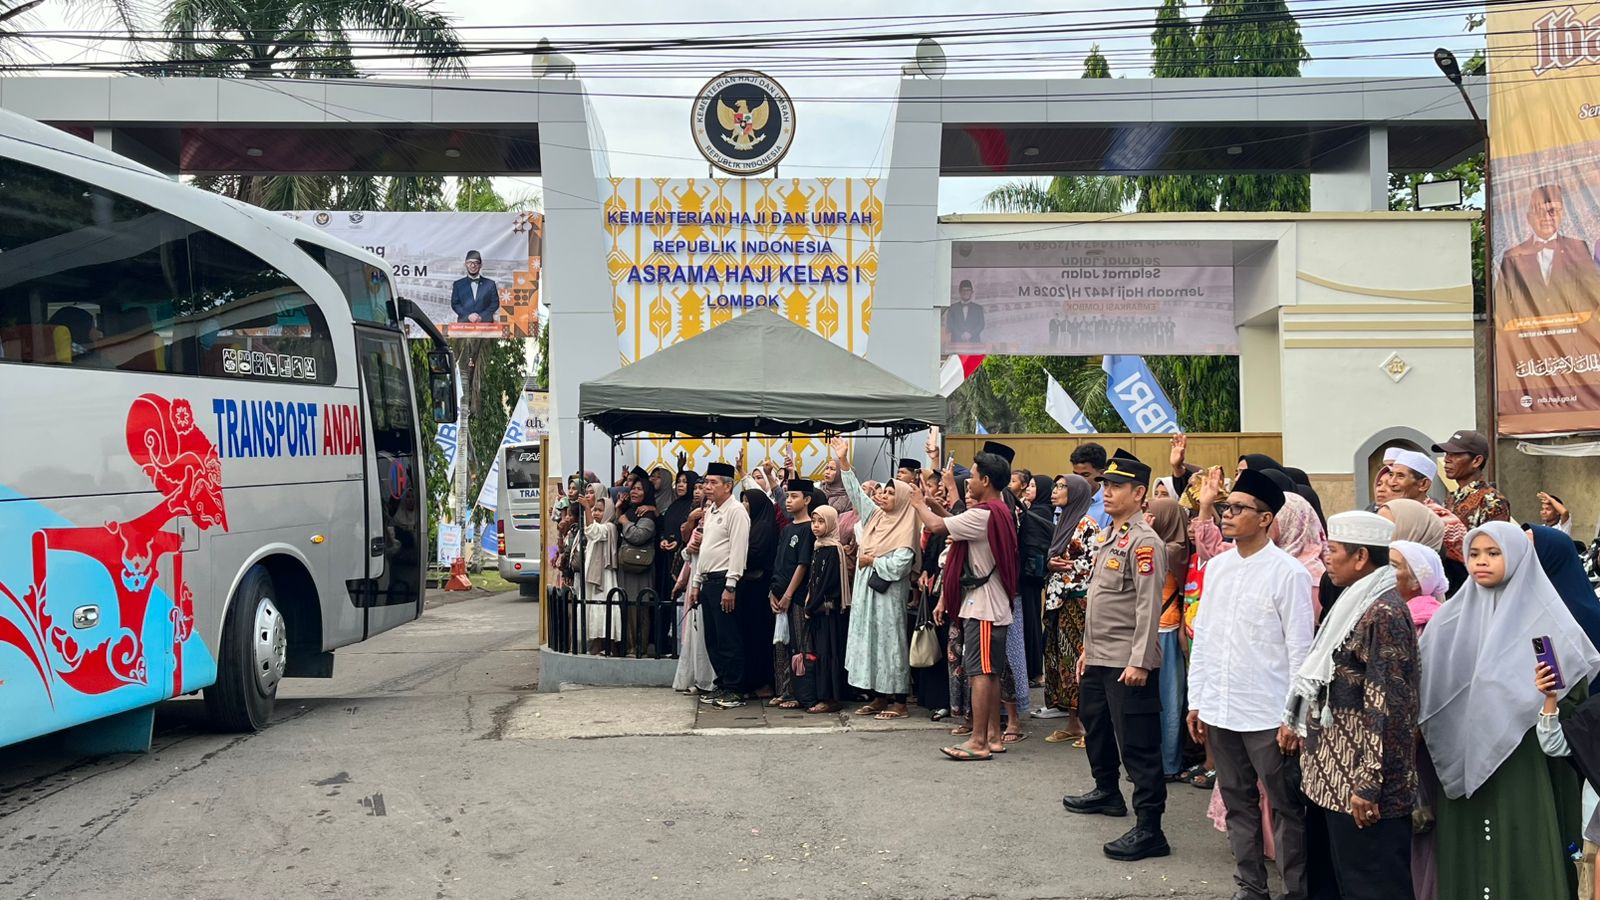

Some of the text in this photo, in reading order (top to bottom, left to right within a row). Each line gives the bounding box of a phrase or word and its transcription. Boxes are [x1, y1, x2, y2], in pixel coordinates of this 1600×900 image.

[696, 76, 736, 123] KEMENTERIAN
[758, 79, 776, 93] DAN
[773, 92, 790, 123] UMRAH
[705, 145, 783, 169] REPUBLIK INDONESIA
[607, 211, 873, 226] KEMENTERIAN HAJI DAN UMRAH
[653, 240, 833, 255] REPUBLIK INDONESIA
[414, 265, 428, 276] M
[627, 265, 861, 284] ASRAMA HAJI KELAS I
[706, 294, 780, 309] LOMBOK
[224, 351, 236, 360] AC
[212, 399, 363, 458] TRANSPORT ANDA
[1110, 548, 1127, 558] POLRI
